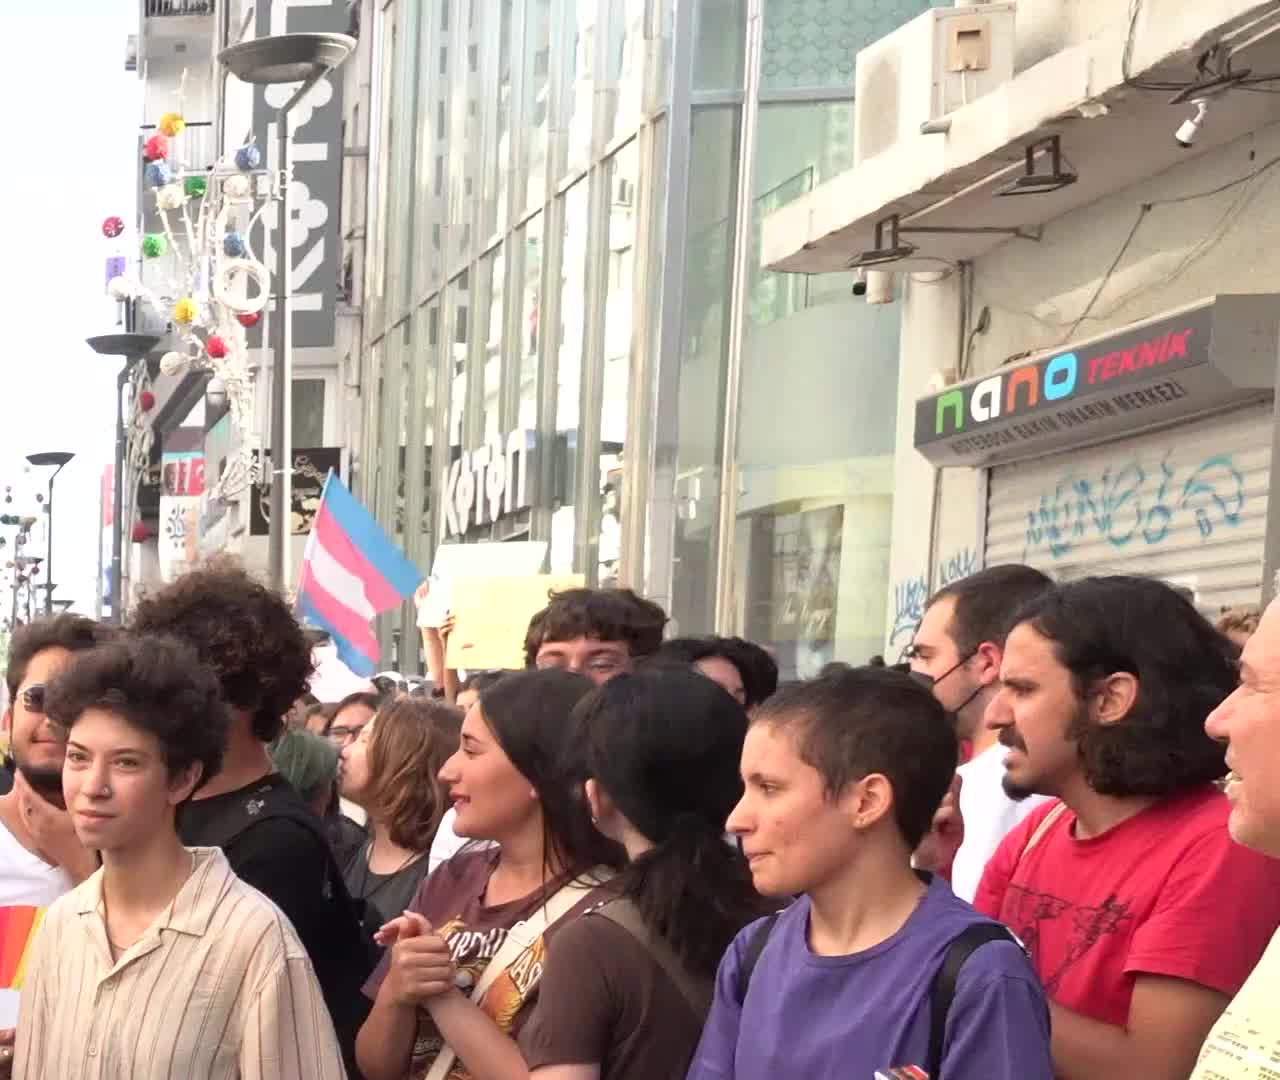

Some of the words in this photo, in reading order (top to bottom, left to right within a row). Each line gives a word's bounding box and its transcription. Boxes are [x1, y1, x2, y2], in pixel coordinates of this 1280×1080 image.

[935, 352, 1078, 434] nano
[1086, 328, 1194, 385] TEKNİK
[439, 430, 528, 541] KOTON
